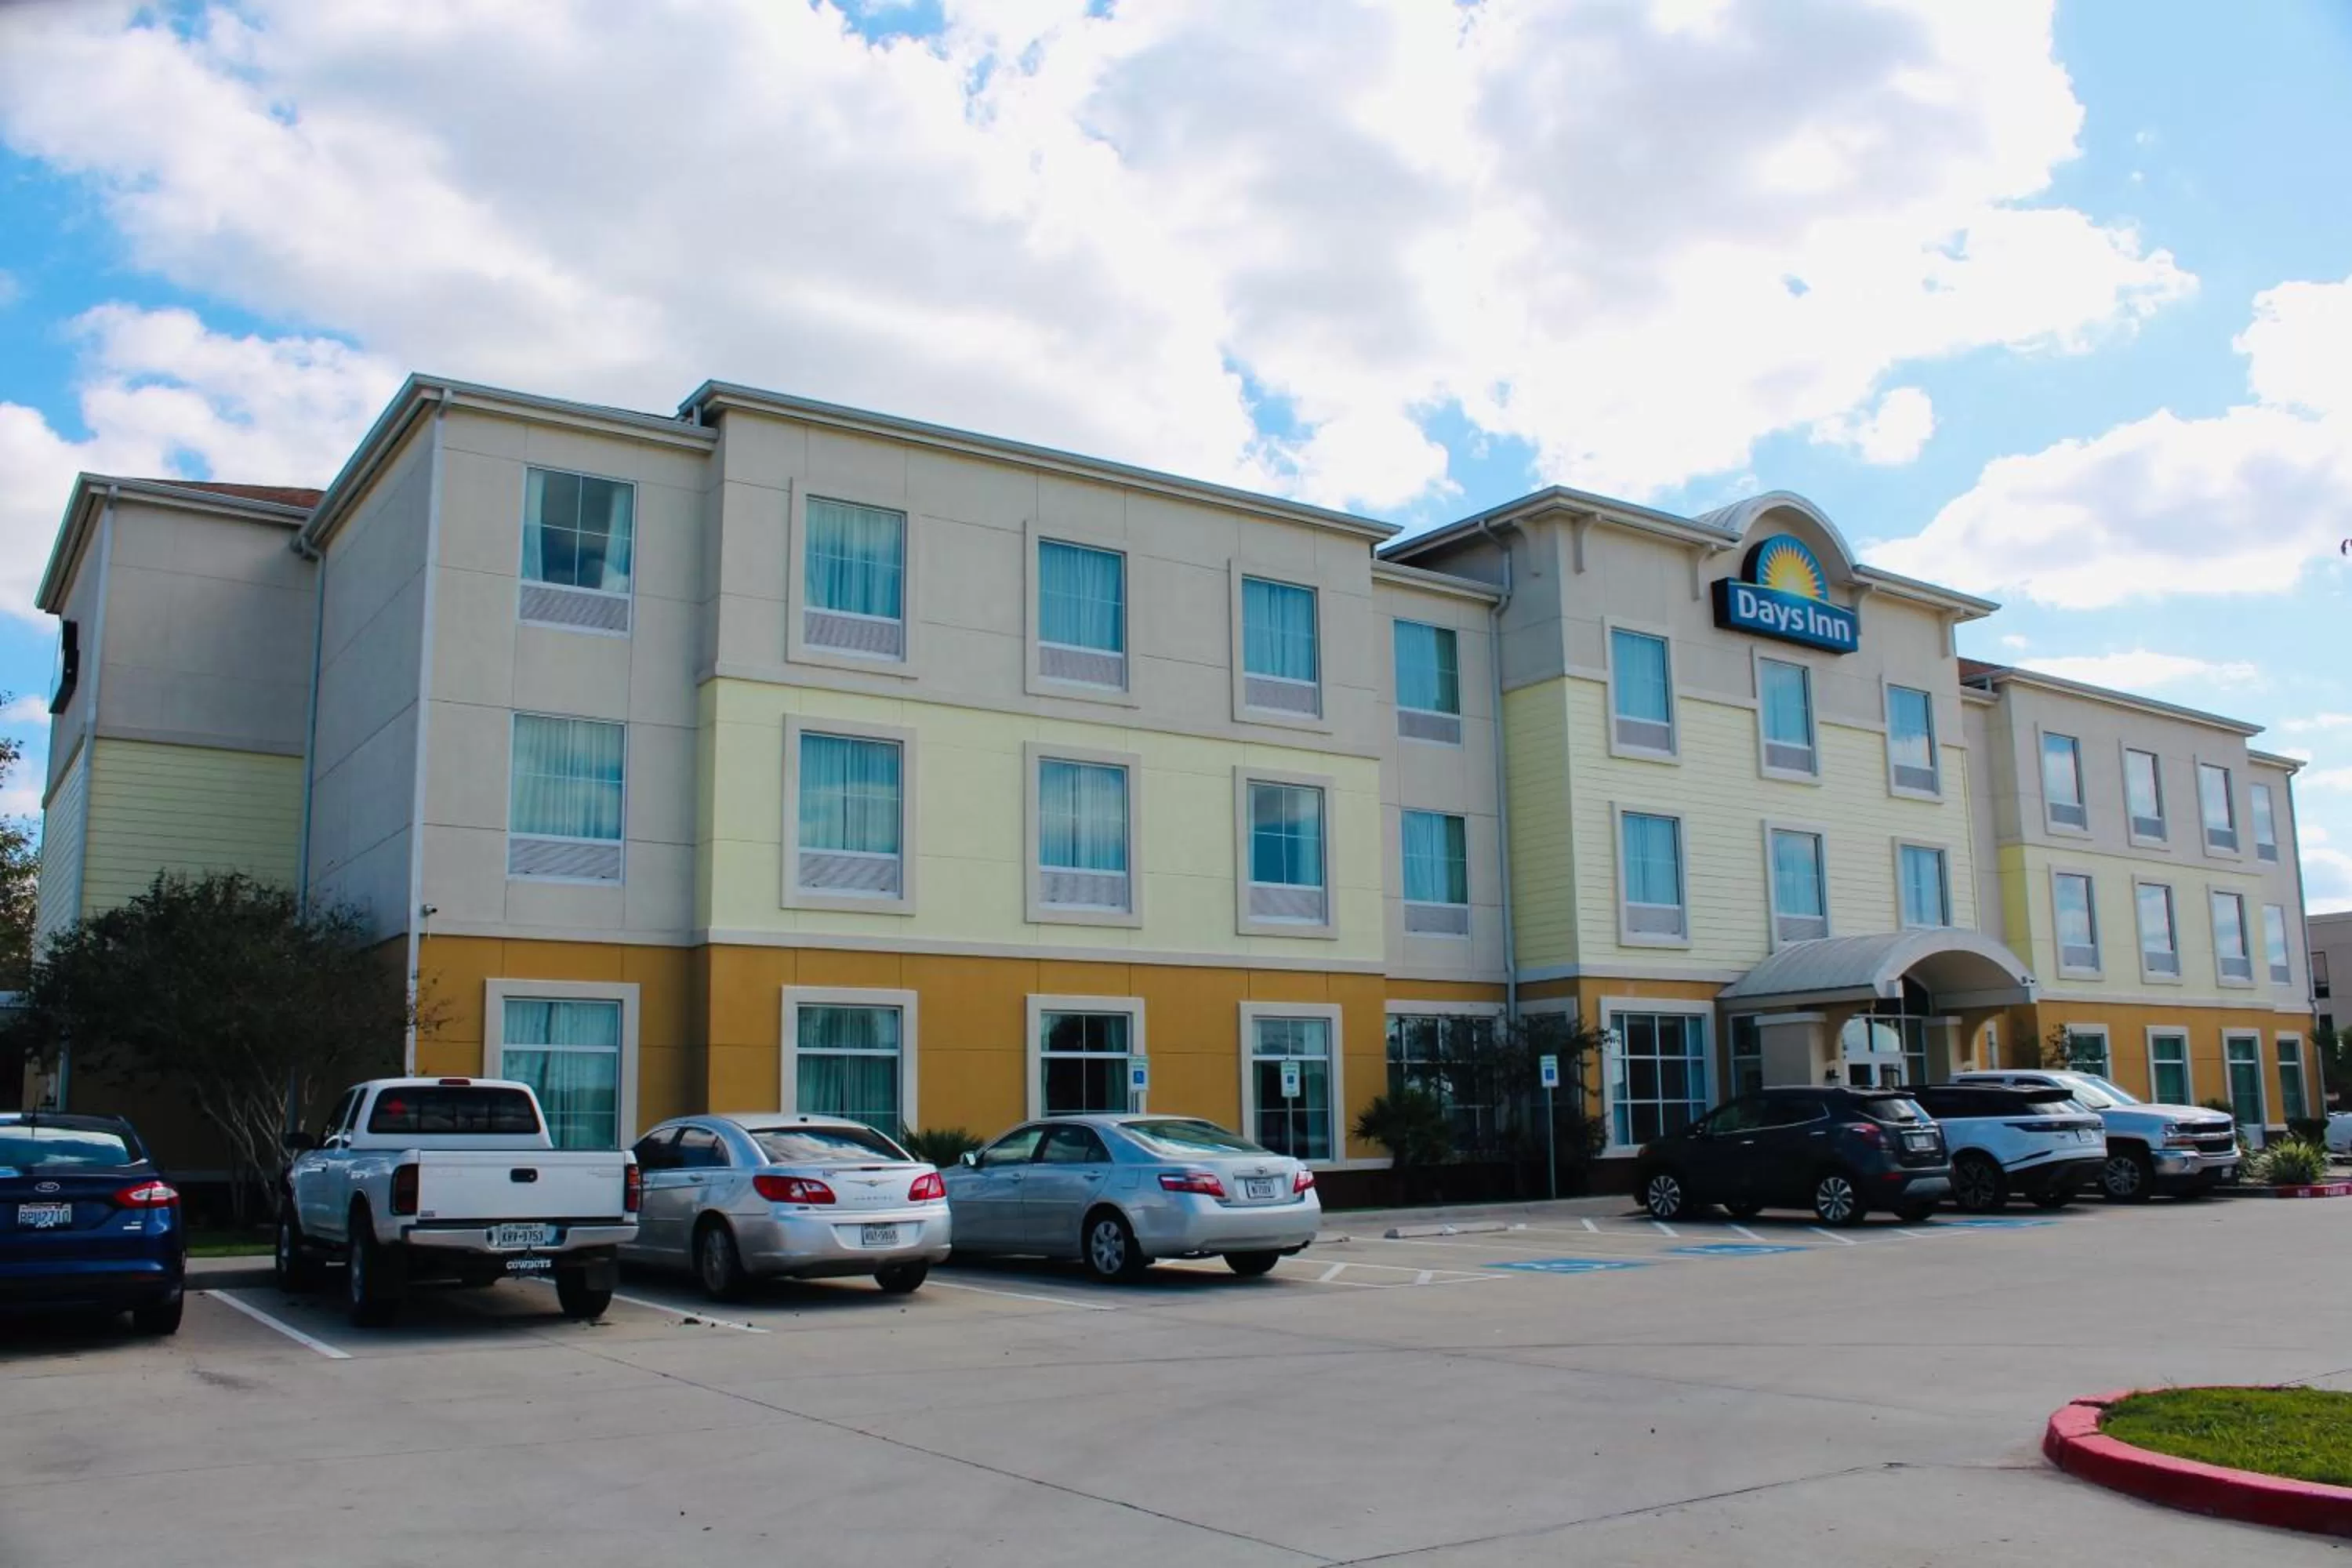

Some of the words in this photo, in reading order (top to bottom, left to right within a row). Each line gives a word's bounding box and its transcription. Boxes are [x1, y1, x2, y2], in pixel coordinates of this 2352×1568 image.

[1737, 590, 1804, 631] Days
[1808, 606, 1850, 641] Inn
[506, 1259, 552, 1269] COWBOYS
